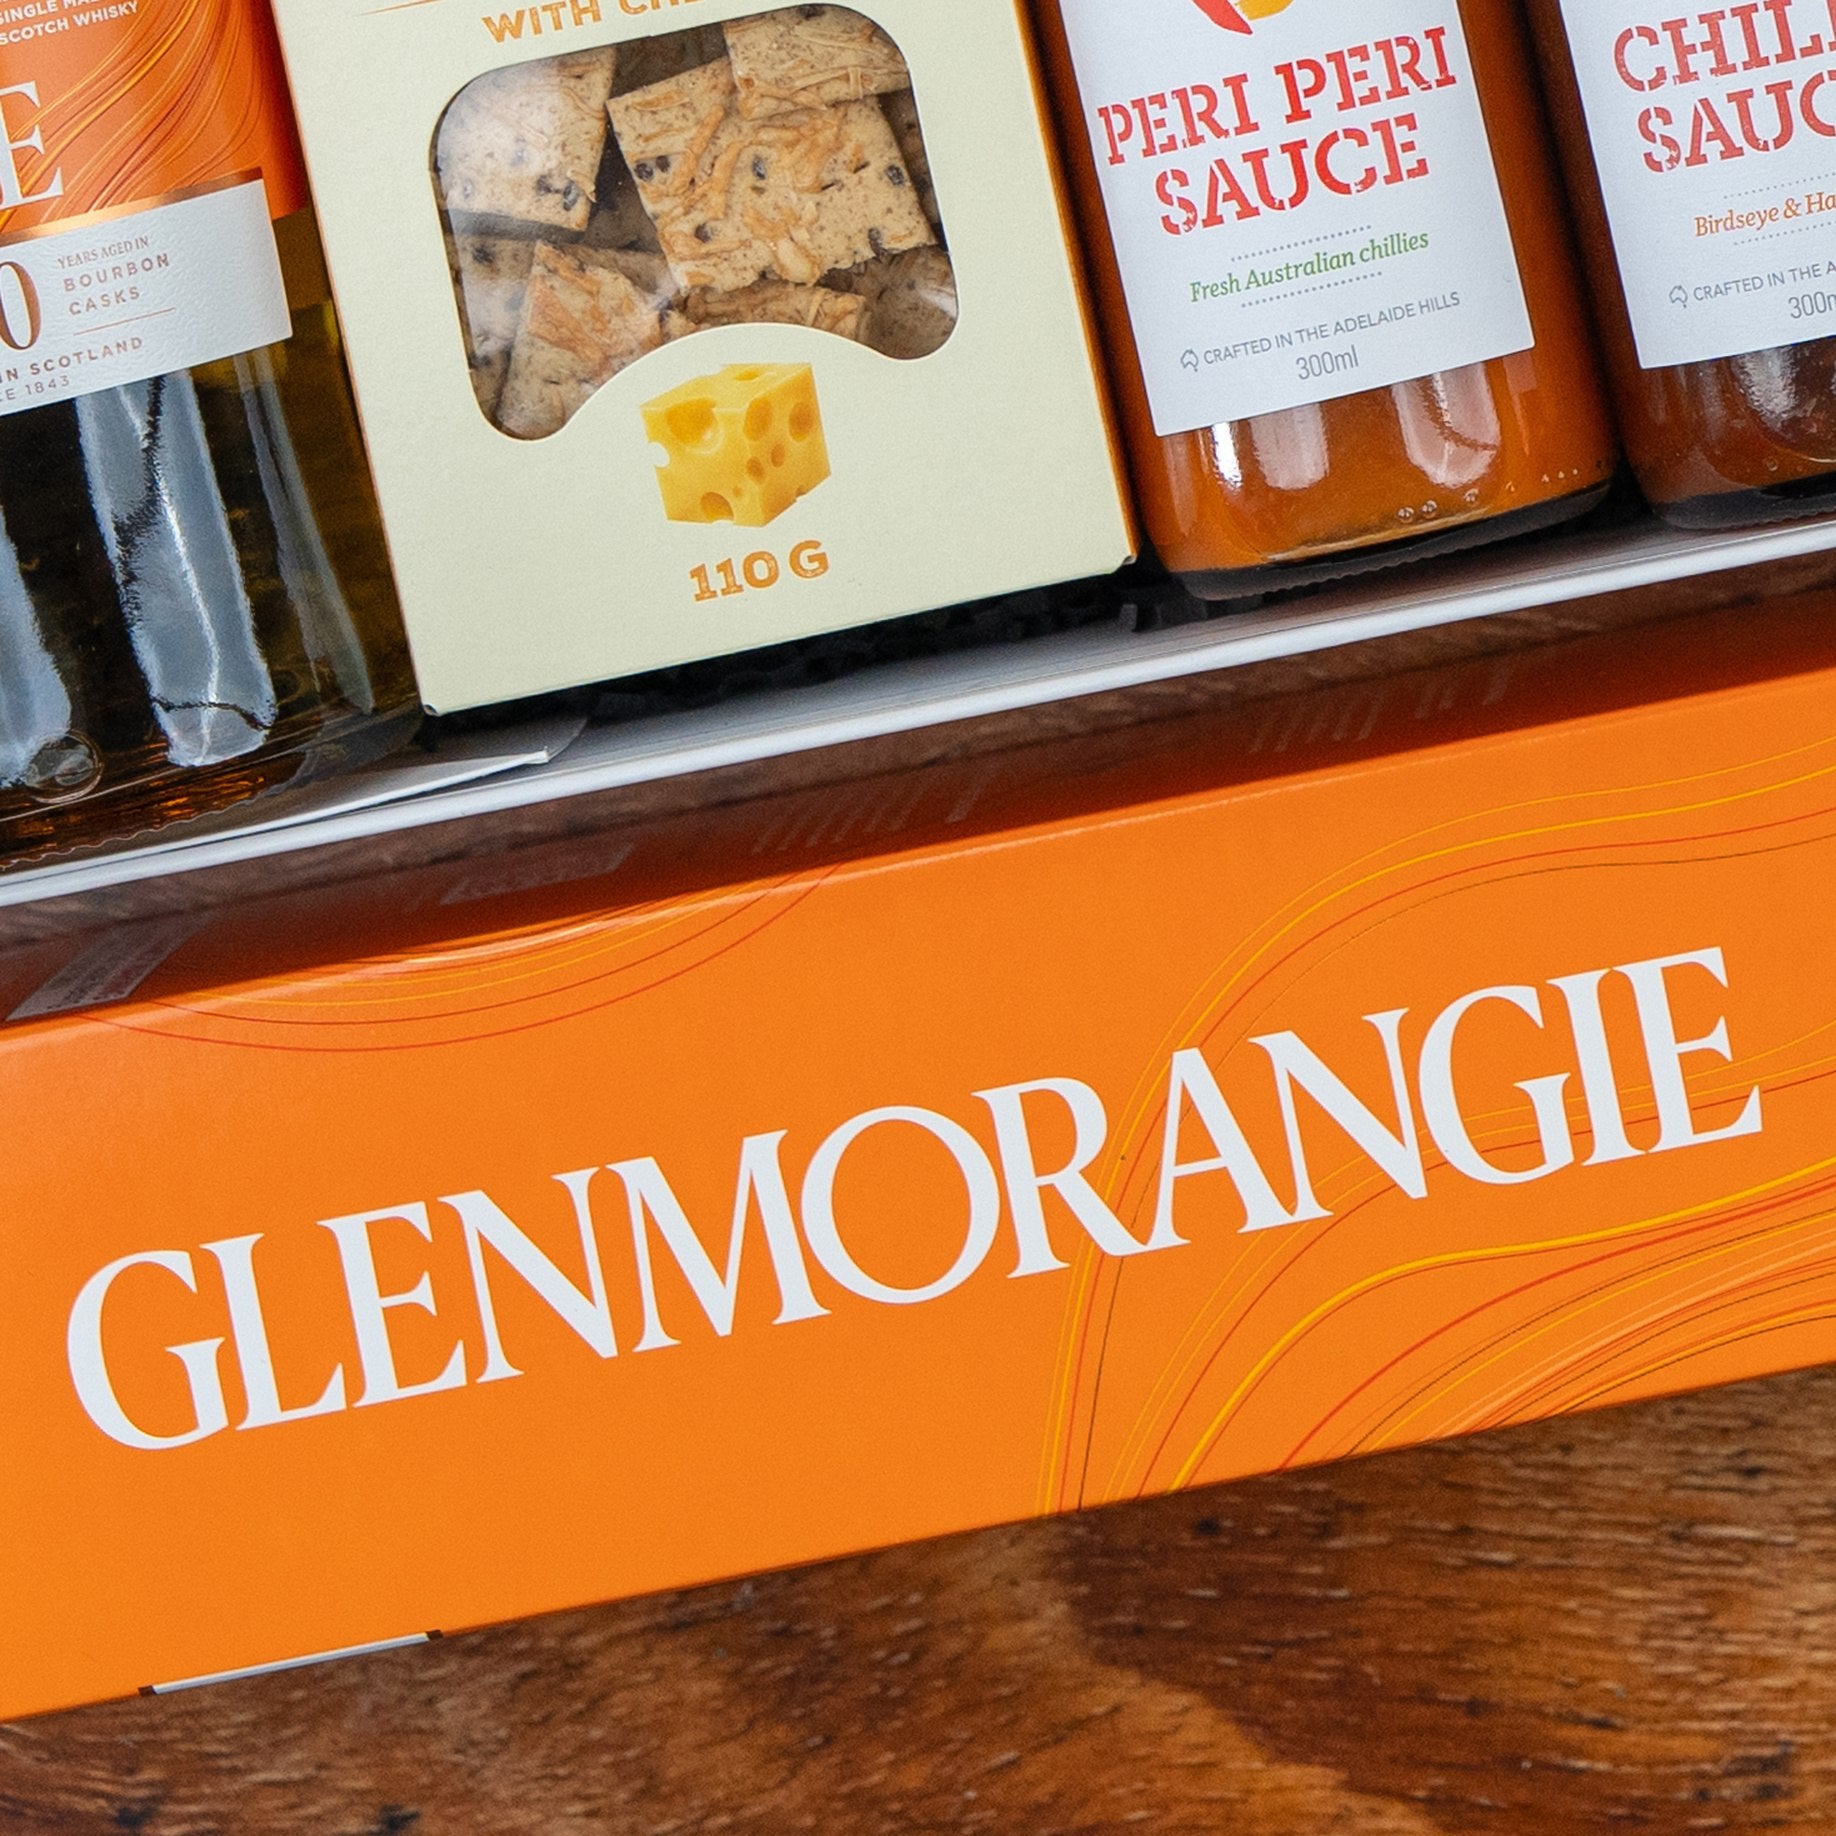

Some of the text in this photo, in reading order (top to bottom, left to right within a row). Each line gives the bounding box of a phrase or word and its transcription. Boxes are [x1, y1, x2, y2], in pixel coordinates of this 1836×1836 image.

[0, 0, 138, 45] SCOTCH WHISKY
[482, 0, 602, 43] WITH
[1097, 26, 1457, 166] PERI PERI
[1154, 112, 1430, 236] SAUCE
[1694, 208, 1780, 237] Birdseye
[1783, 197, 1802, 220] &
[57, 235, 149, 270] YEARS AGED IN
[63, 253, 170, 292] BOURBON
[1189, 232, 1430, 303] Fresh Australian chillies
[69, 287, 140, 316] CASKS
[1693, 276, 1764, 302] CRAFTED
[1767, 271, 1786, 288] IN
[1788, 263, 1823, 283] THE
[1203, 291, 1461, 365] CRAFTED IN THE ADELAIDE HILLS
[30, 337, 142, 376] SCOTLAND
[1296, 343, 1359, 380] 300ml
[25, 375, 70, 395] 1843
[689, 539, 830, 602] 110 G
[66, 945, 1764, 1452] GLENMORANGIE
